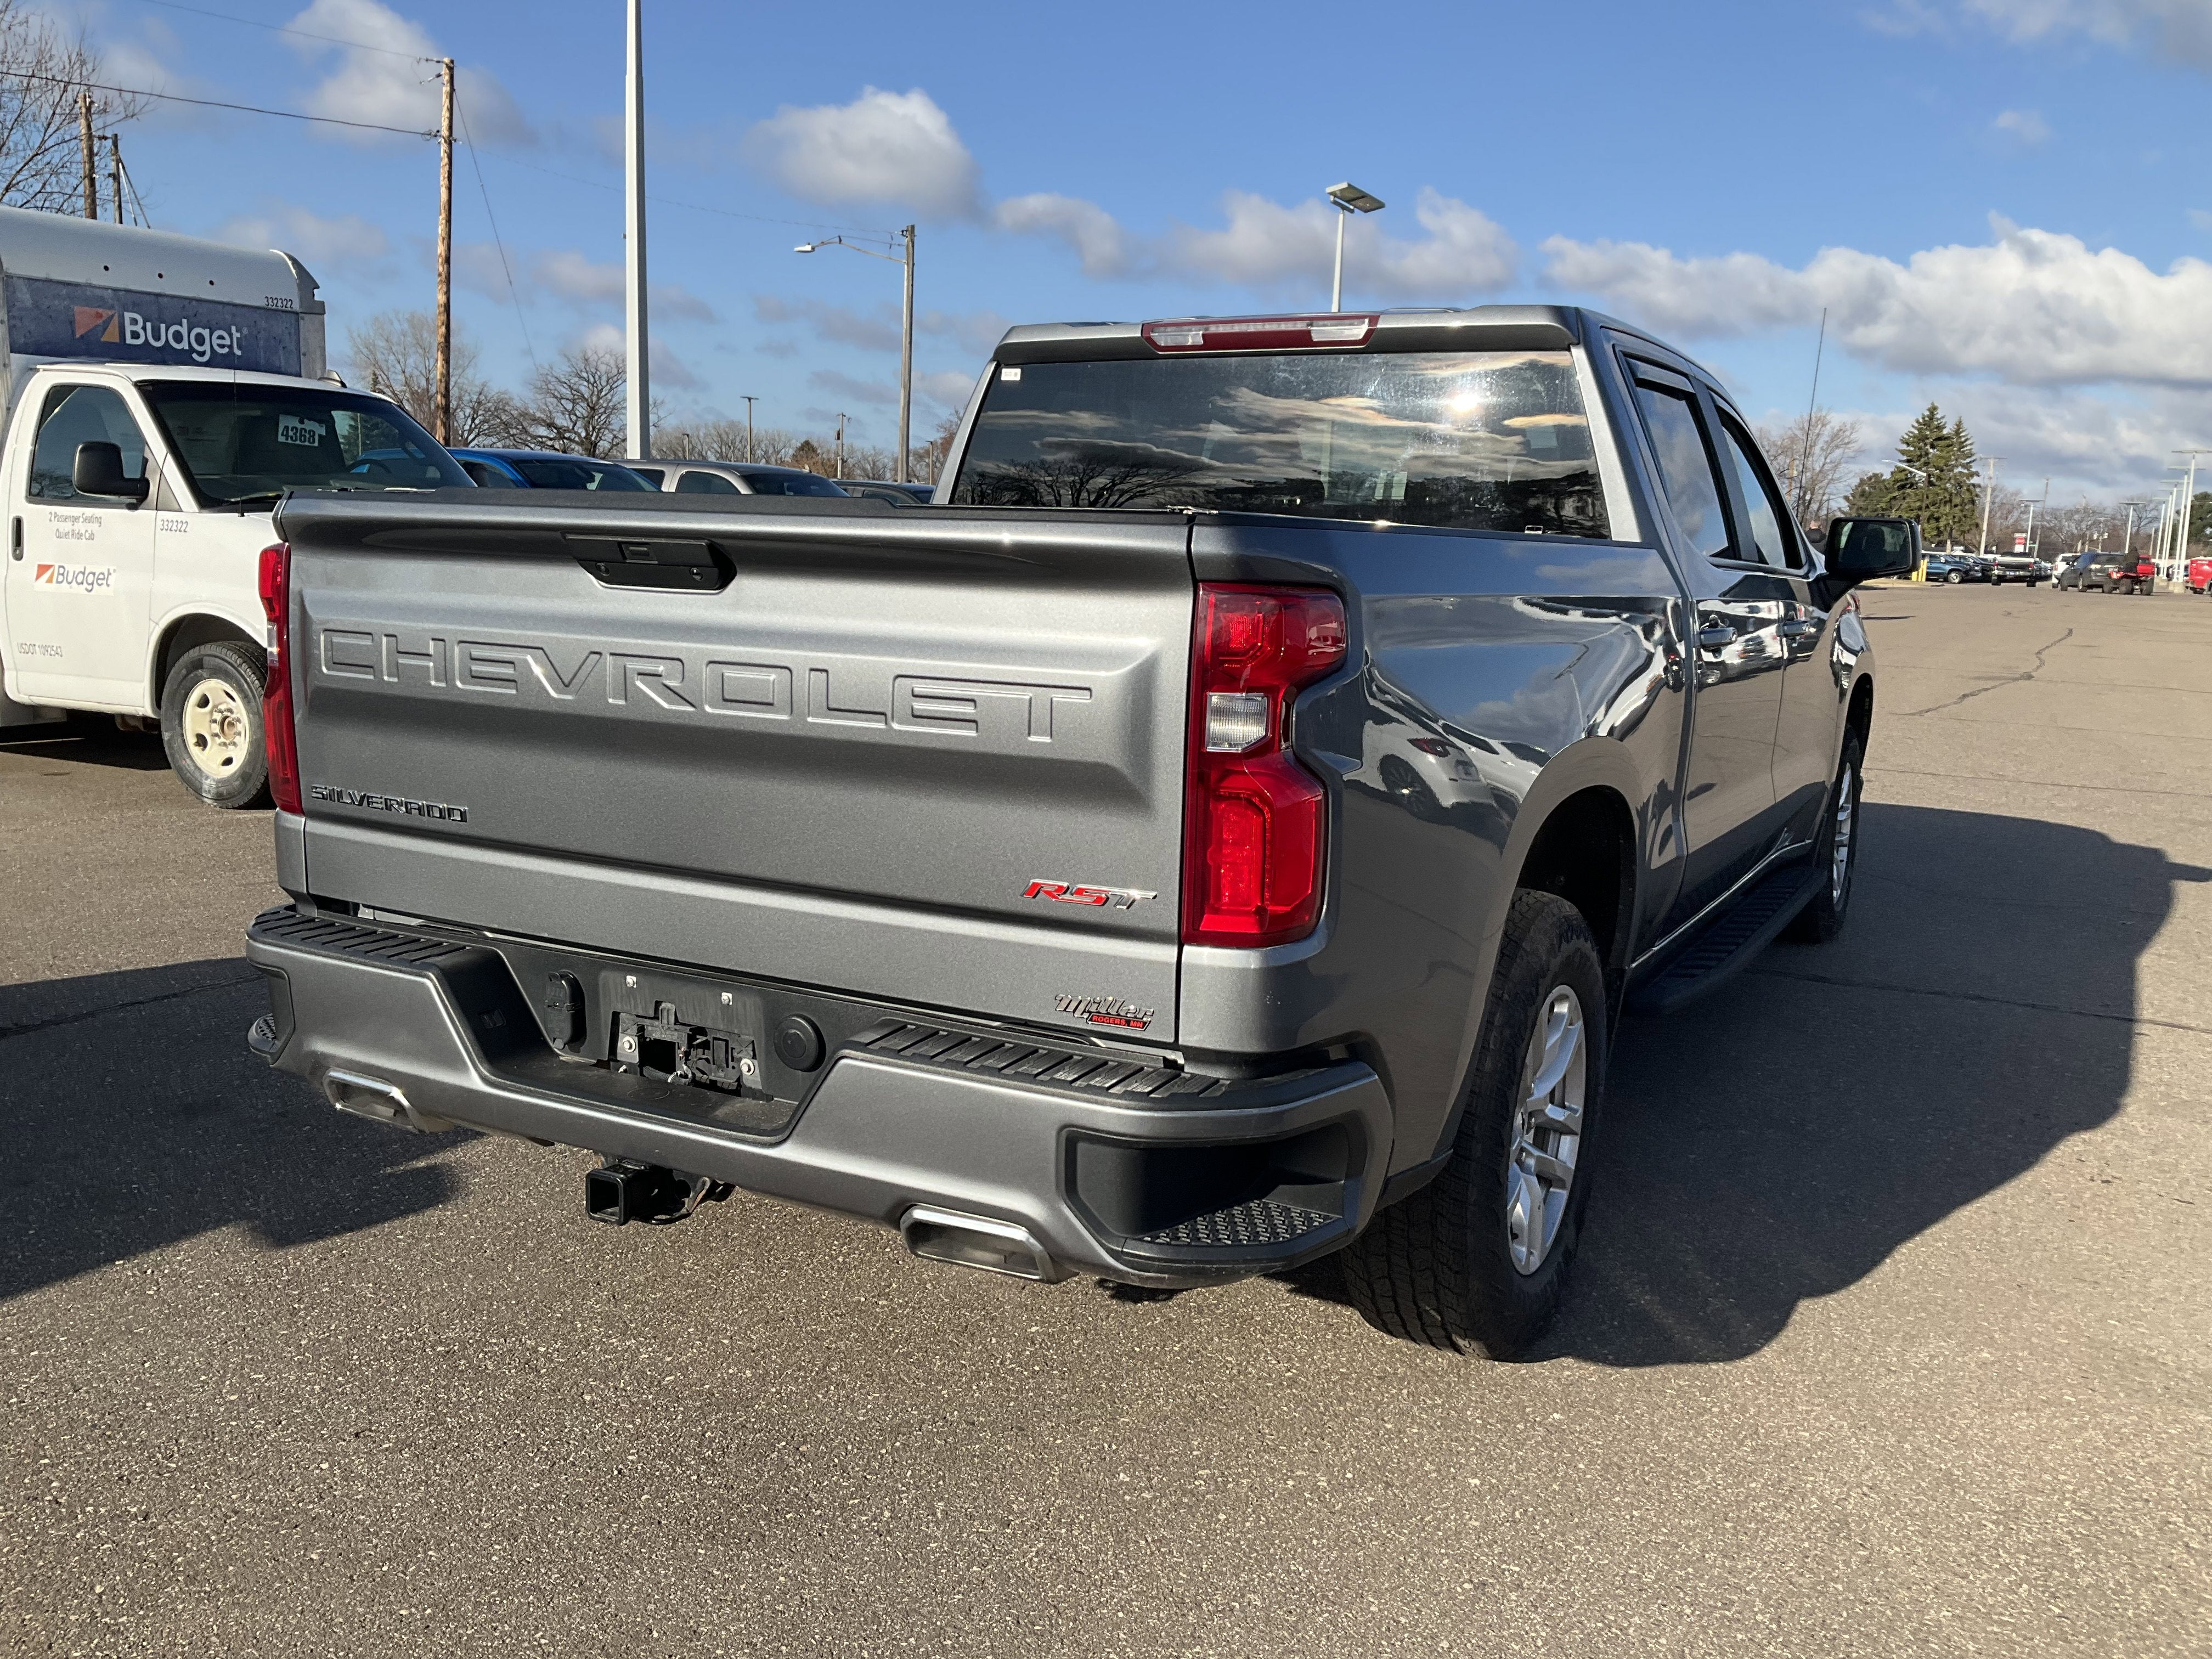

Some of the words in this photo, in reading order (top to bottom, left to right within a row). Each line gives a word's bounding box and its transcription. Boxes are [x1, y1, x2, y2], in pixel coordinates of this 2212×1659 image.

[264, 296, 294, 309] 332322
[124, 312, 242, 363] Budget
[281, 425, 316, 444] 4368
[48, 512, 52, 522] 2
[54, 512, 81, 526] Passenger
[82, 513, 102, 527] Seating
[160, 519, 188, 533] 332322
[55, 528, 70, 539] Quiet
[71, 529, 83, 540] Ride
[84, 529, 94, 540] Cab
[55, 565, 112, 592] Budget
[17, 642, 37, 654] USDOT
[321, 629, 1092, 742] CHEVROLET
[311, 785, 469, 823] SILVERADO
[1020, 878, 1158, 910] RST
[1054, 994, 1154, 1021] Miller
[1092, 1015, 1128, 1027] ROGERS,
[1130, 1020, 1144, 1028] MN
